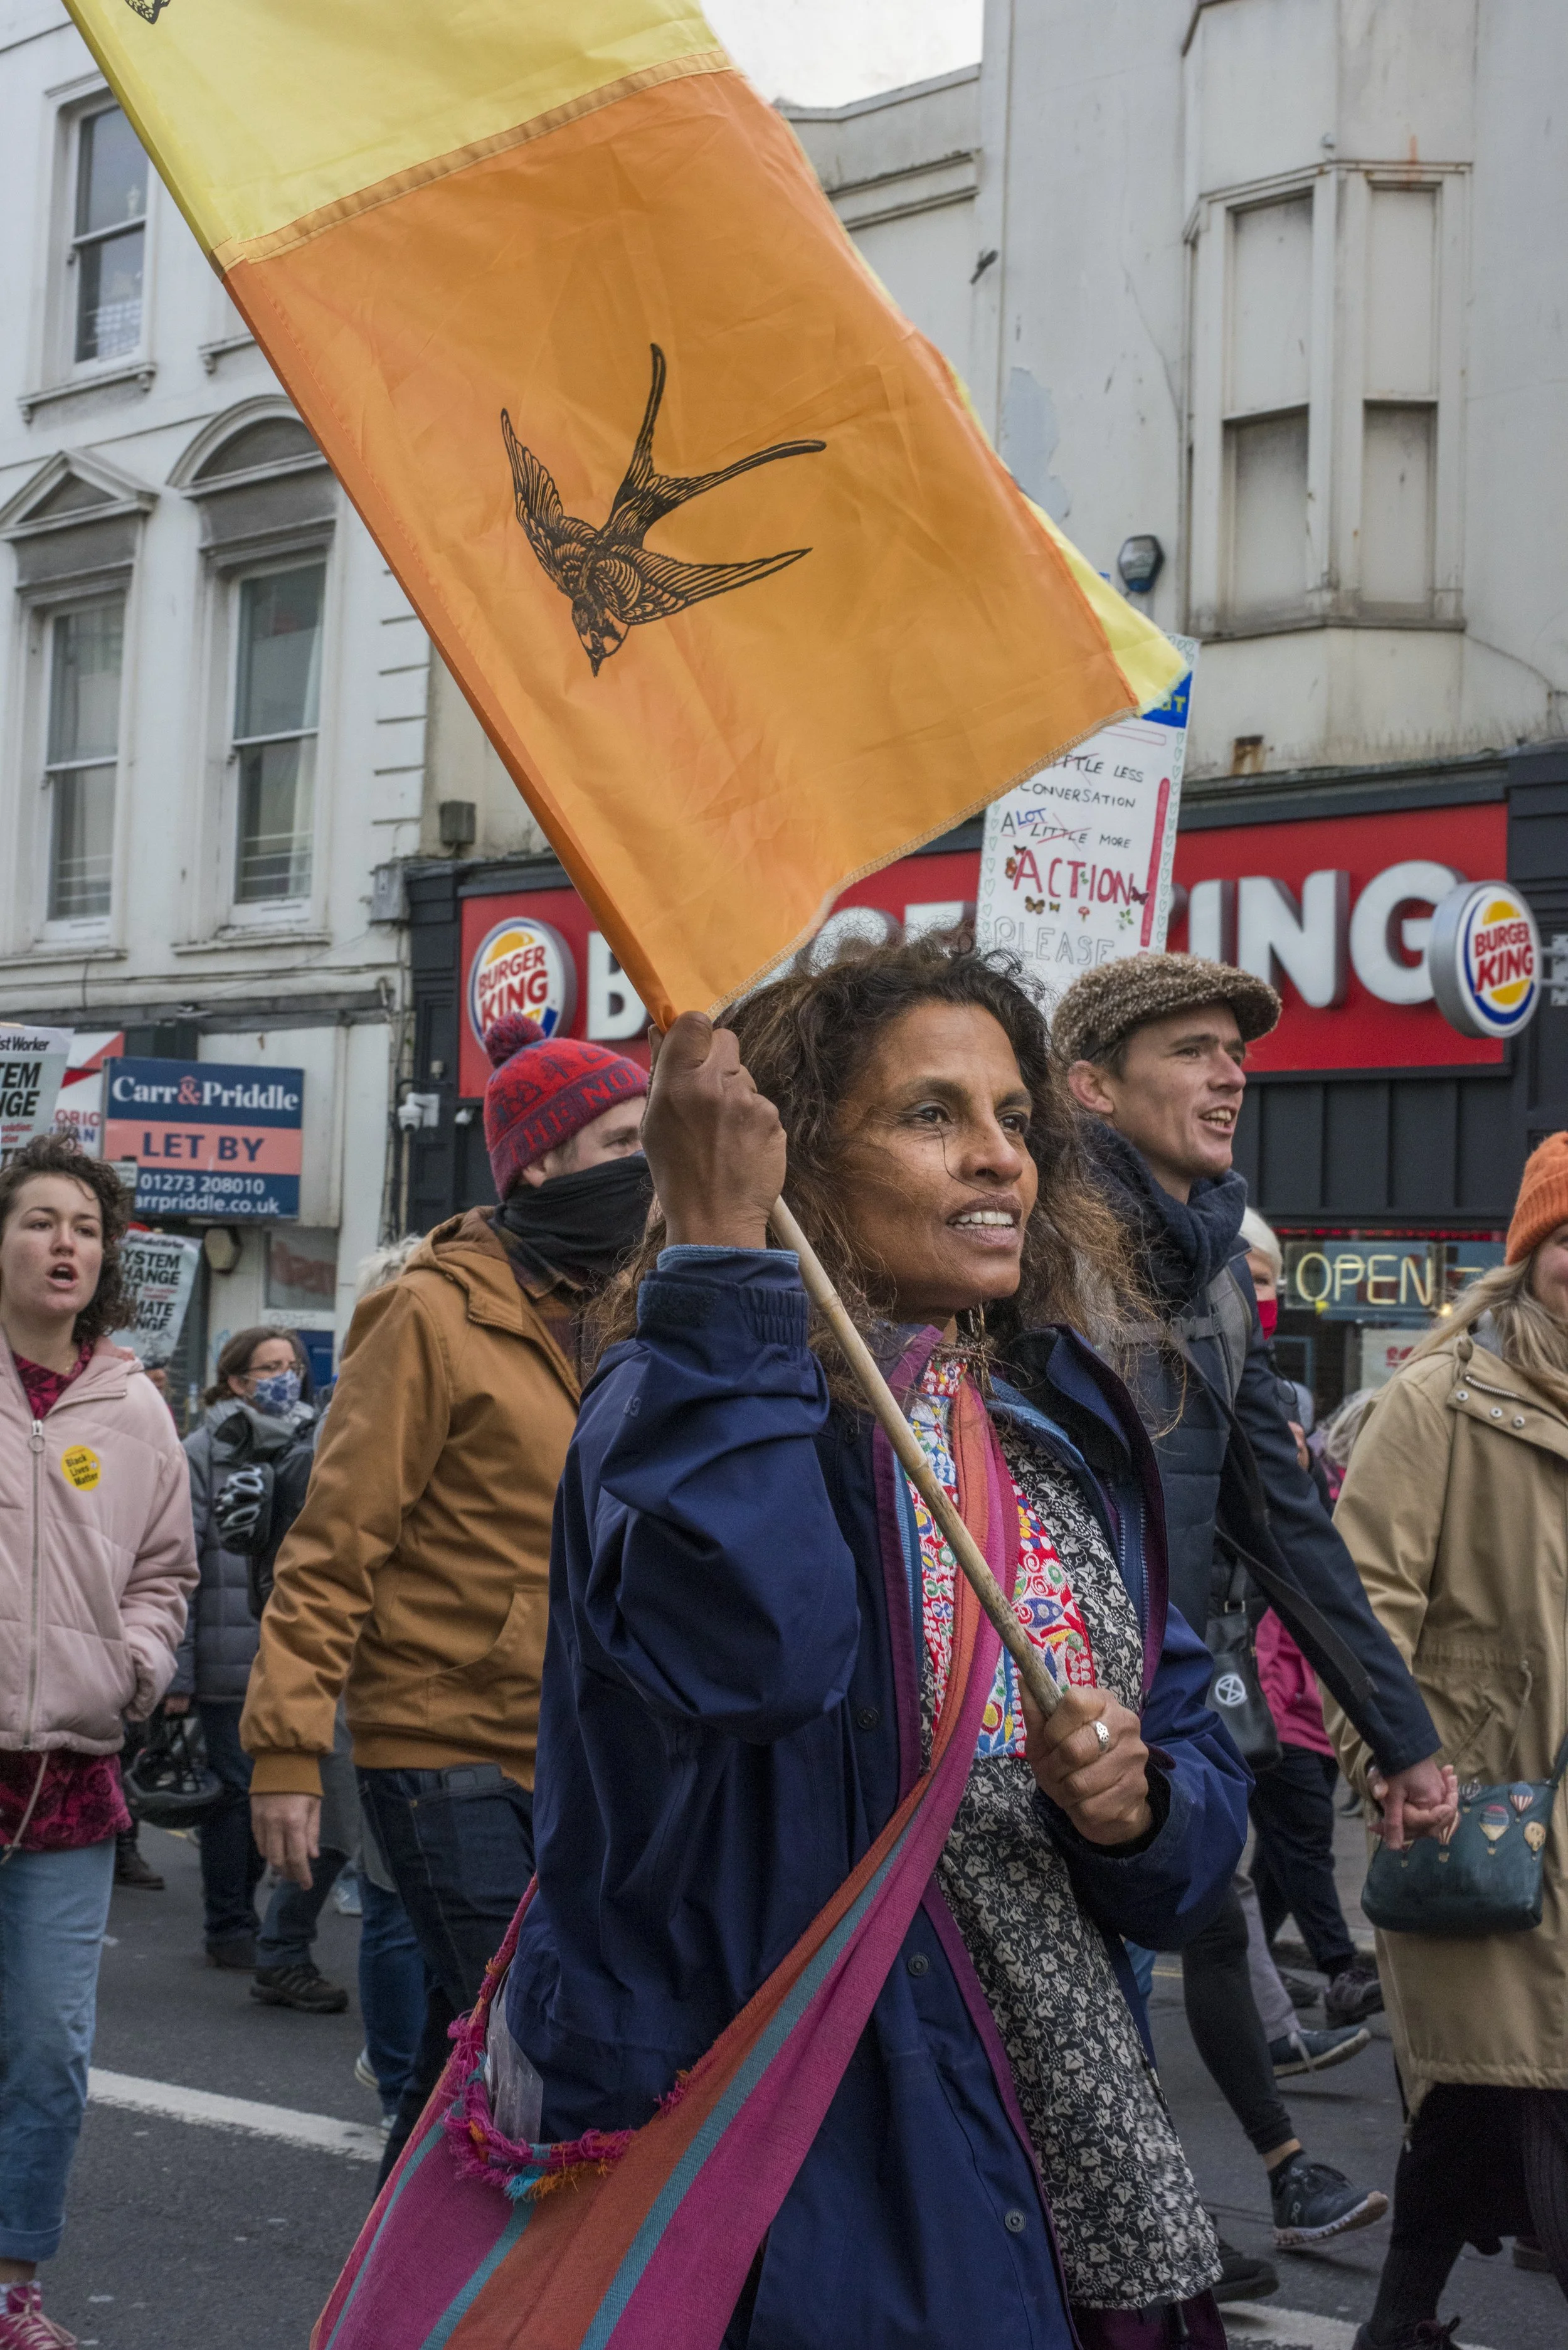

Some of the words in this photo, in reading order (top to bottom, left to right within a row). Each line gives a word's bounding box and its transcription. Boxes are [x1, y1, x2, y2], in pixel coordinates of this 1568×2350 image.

[1113, 764, 1145, 784] LESS
[1020, 780, 1136, 809] CONVERSATION
[1000, 811, 1016, 835] A
[1017, 807, 1047, 826] LOT
[1030, 822, 1088, 843] LITTLE
[1100, 833, 1133, 849] MORE
[1013, 849, 1134, 907] ACTION
[994, 916, 1115, 965] PLEASE
[1169, 859, 1457, 1009] ING
[1475, 922, 1530, 958] BURGER
[479, 945, 546, 999] BURGER
[1475, 944, 1534, 994] KING
[481, 969, 548, 1034] KING
[12, 1036, 50, 1052] Worker
[142, 1131, 205, 1159] LET
[218, 1135, 265, 1163] BY
[140, 1173, 195, 1192] 01273
[199, 1175, 265, 1195] 208010
[134, 1193, 281, 1215] arrpriddle.co.uk
[124, 1250, 181, 1270] YSTEM
[1295, 1252, 1433, 1306] OPEN
[65, 1454, 87, 1468] Black
[69, 1465, 90, 1477] Lives
[74, 1472, 98, 1487] Matter
